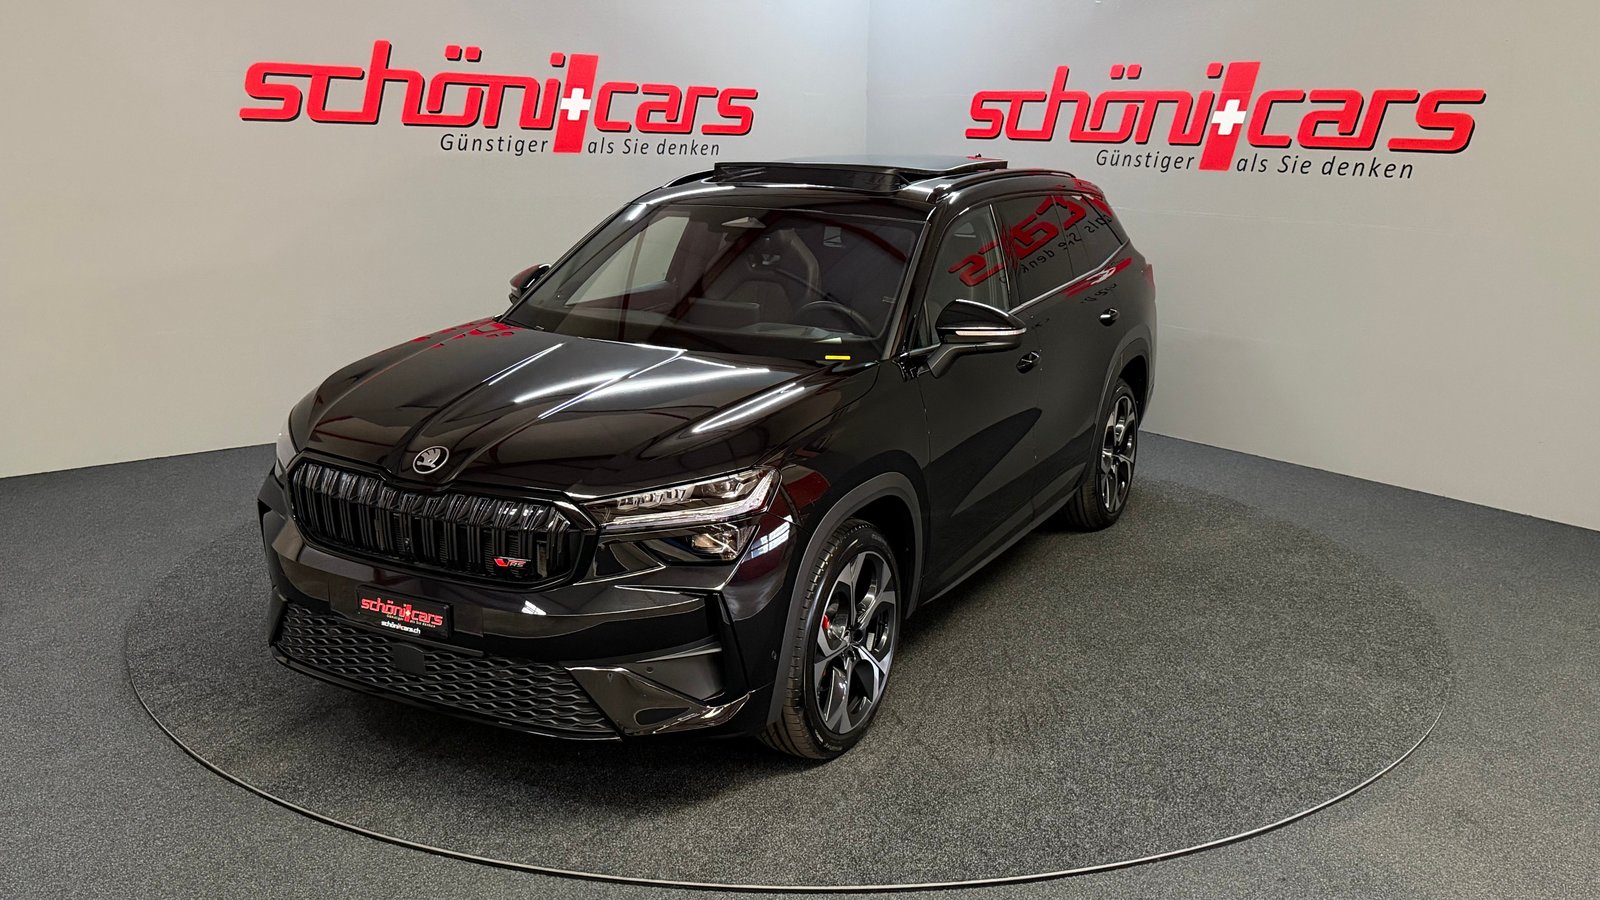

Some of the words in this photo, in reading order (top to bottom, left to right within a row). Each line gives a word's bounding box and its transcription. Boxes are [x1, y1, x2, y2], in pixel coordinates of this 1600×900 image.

[440, 133, 548, 156] Günstiger
[587, 137, 615, 155] als
[622, 138, 649, 155] Sie
[656, 138, 720, 156] denken
[1096, 149, 1195, 172] Günstiger
[1236, 154, 1268, 174] als
[1277, 154, 1312, 175] Sie
[1321, 155, 1414, 179] denken
